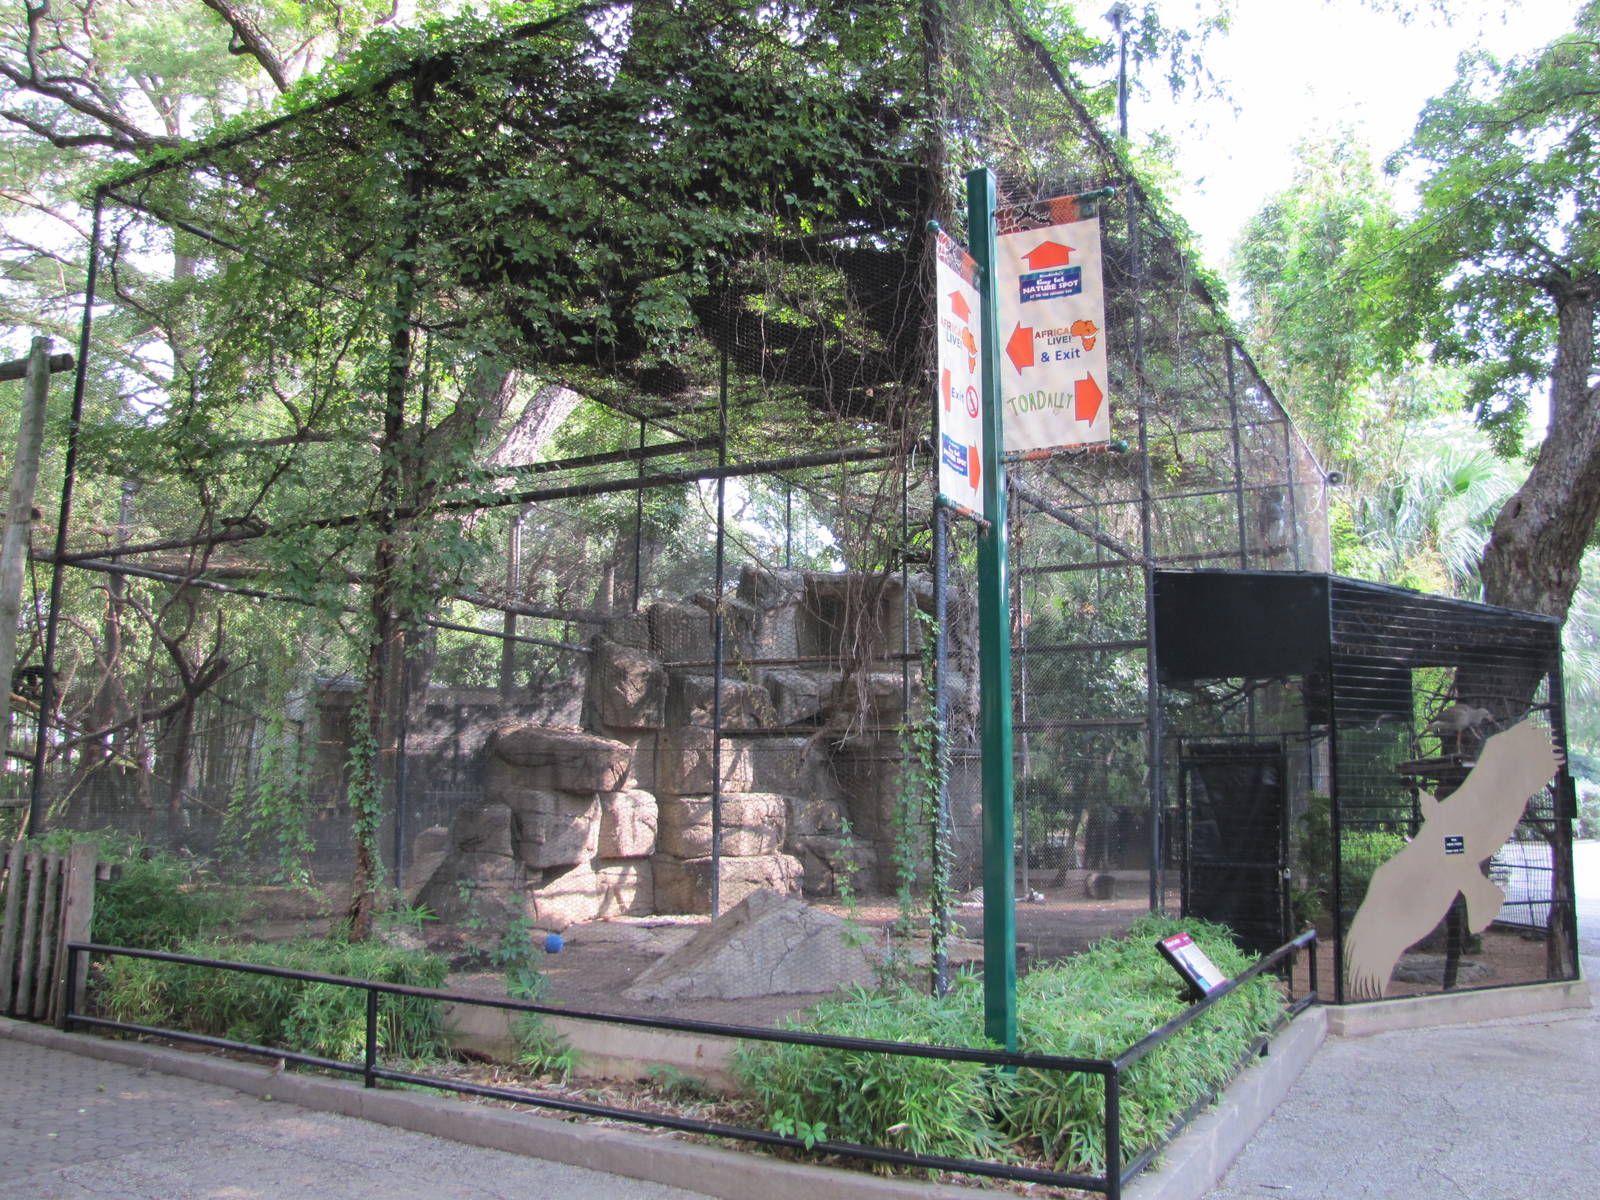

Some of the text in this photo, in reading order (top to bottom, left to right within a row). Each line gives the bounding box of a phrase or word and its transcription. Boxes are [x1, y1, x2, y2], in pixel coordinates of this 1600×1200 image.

[1023, 283, 1056, 294] NATURE
[1059, 279, 1078, 289] SPOT
[1047, 335, 1072, 345] LIVE!
[1041, 348, 1081, 362] & Exit
[952, 387, 964, 401] Exit
[1006, 390, 1073, 416] TOADALLY
